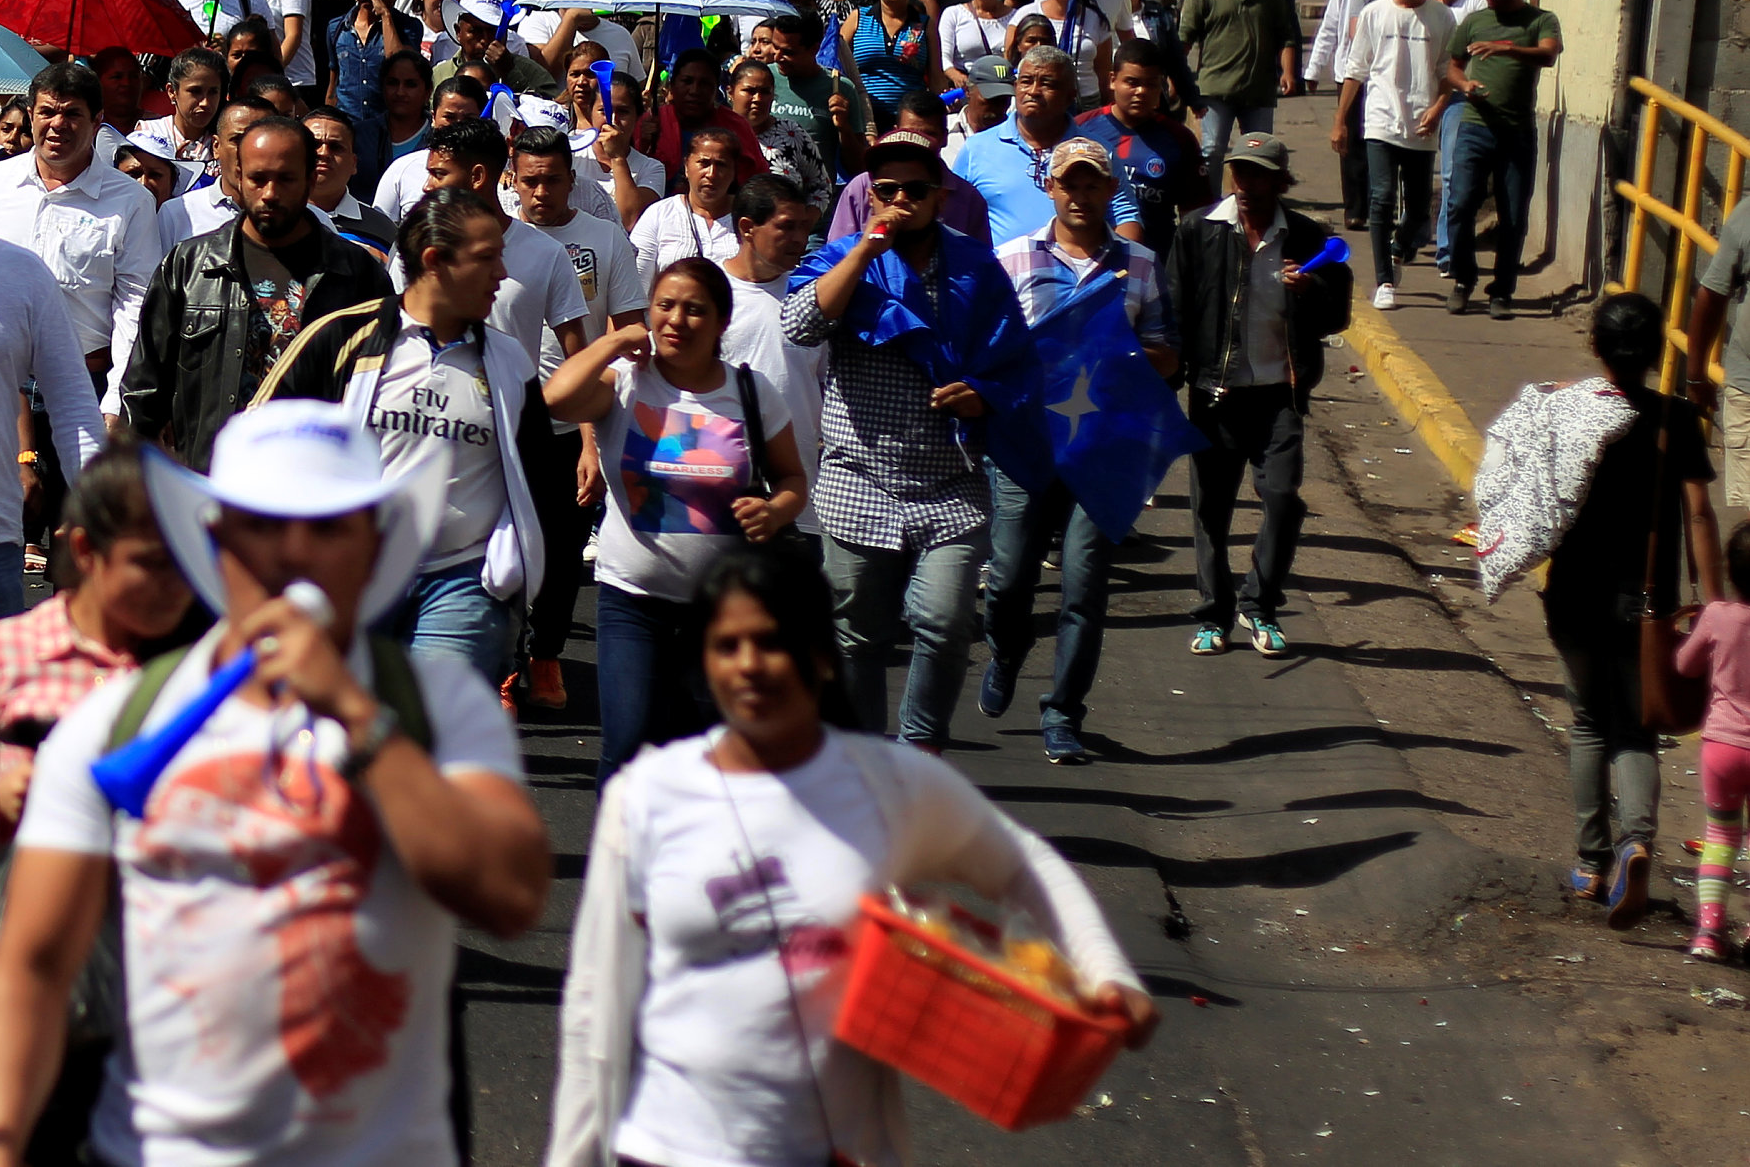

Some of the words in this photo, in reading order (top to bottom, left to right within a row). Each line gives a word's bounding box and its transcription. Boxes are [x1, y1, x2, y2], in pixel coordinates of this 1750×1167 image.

[1069, 142, 1090, 153] CAT
[411, 386, 450, 412] Fly
[654, 463, 724, 475] FEARLESS
